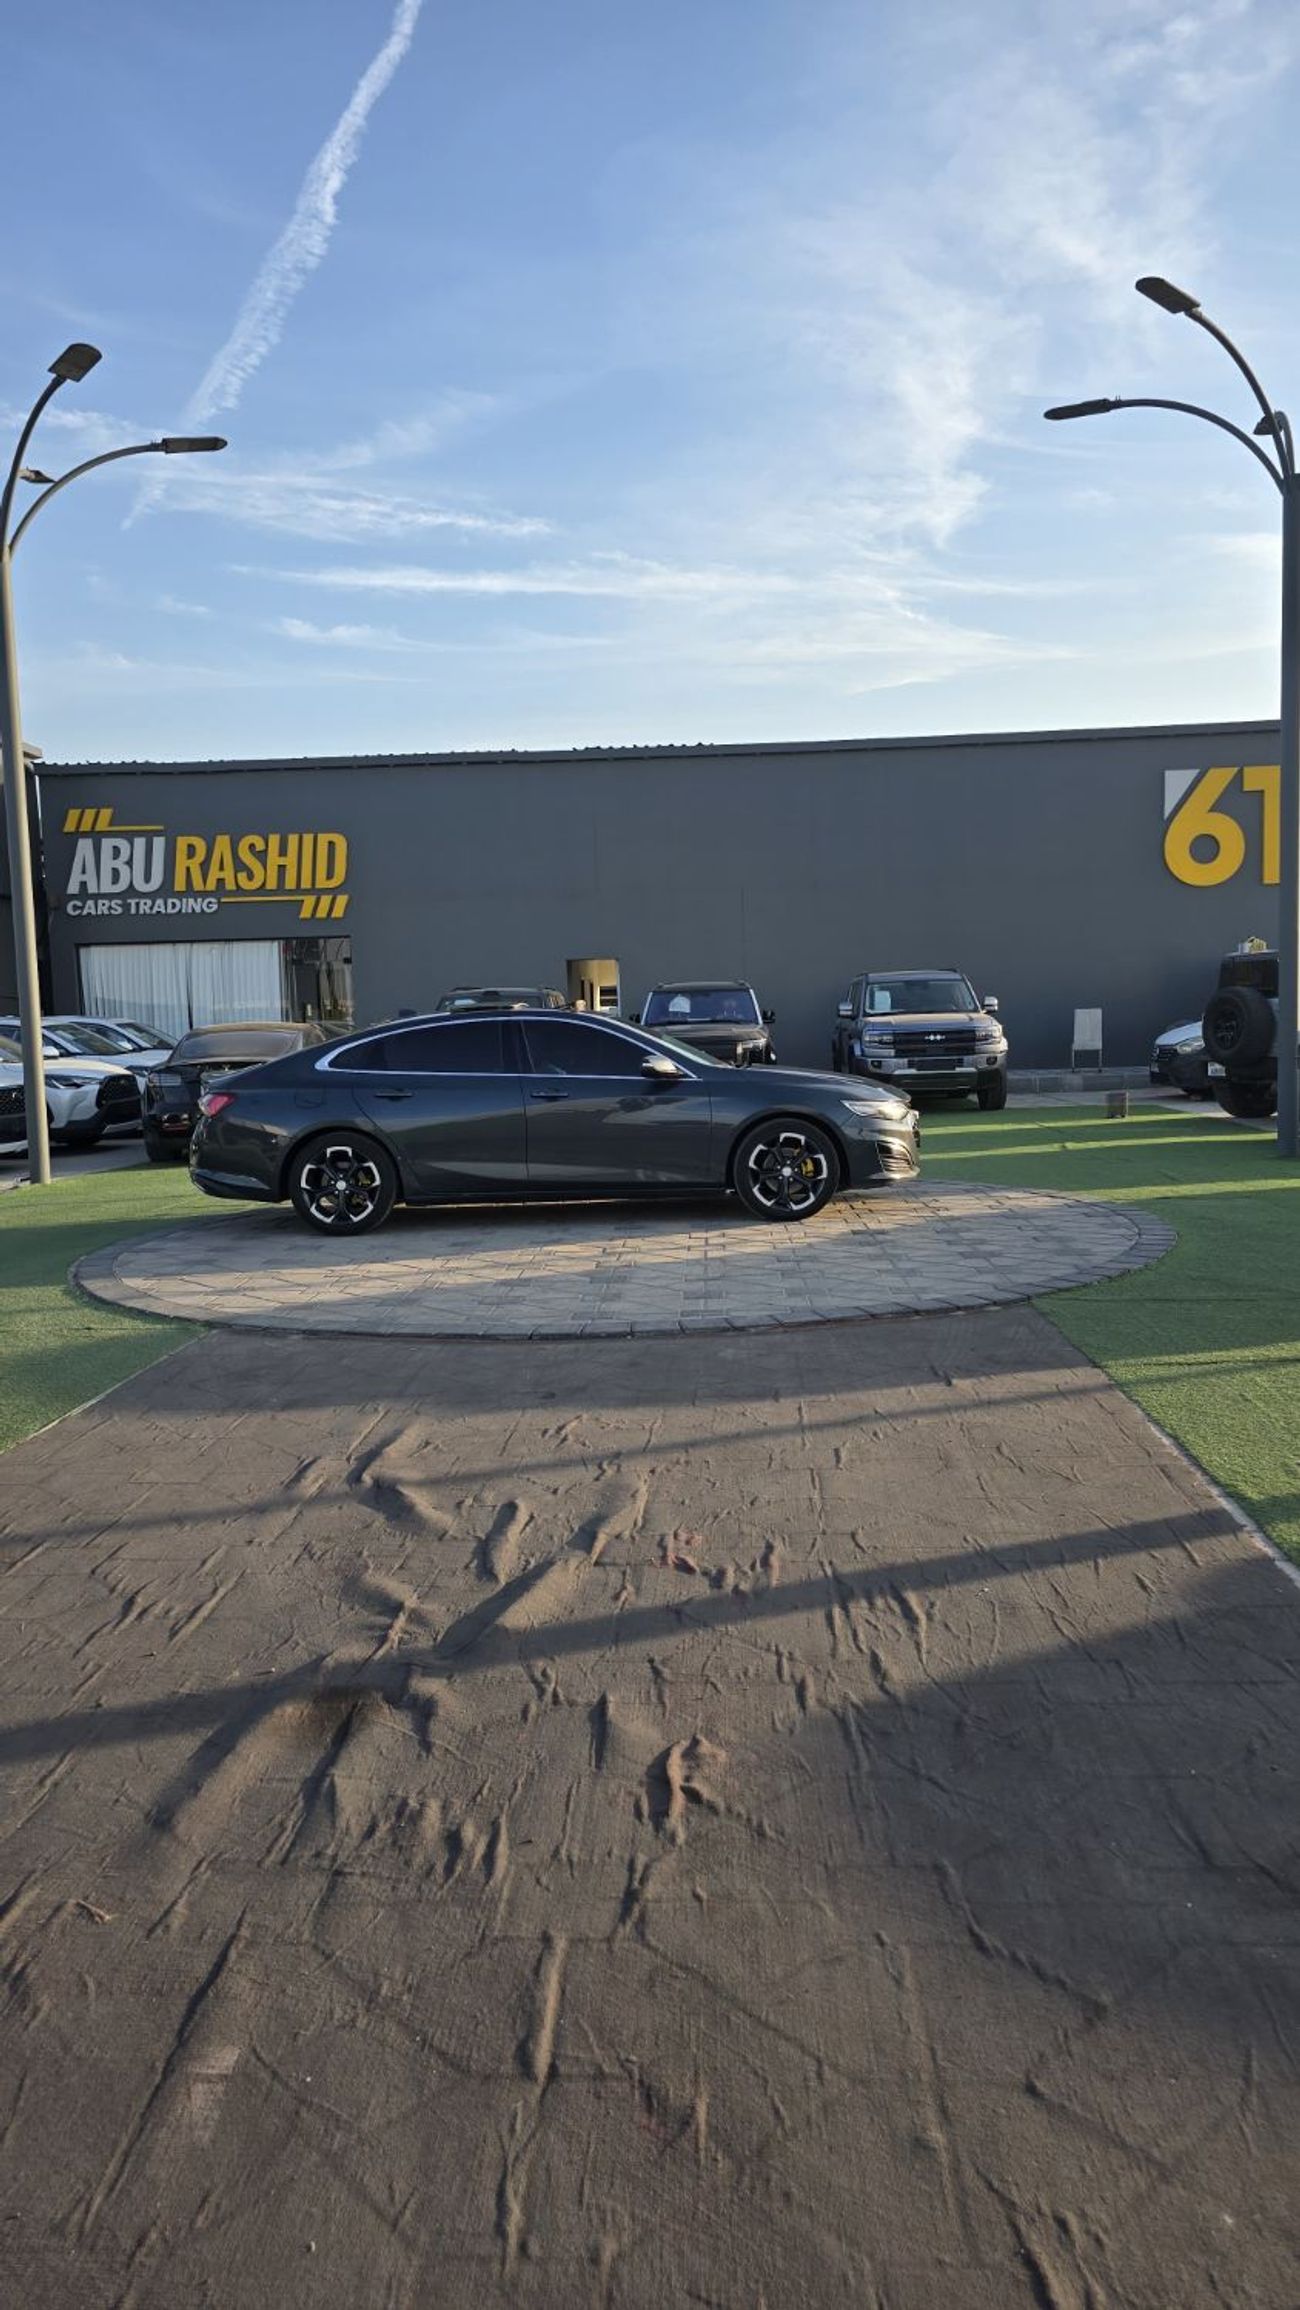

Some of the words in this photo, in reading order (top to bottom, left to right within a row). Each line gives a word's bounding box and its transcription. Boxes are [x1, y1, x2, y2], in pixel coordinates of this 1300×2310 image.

[1164, 764, 1281, 887] 61
[66, 836, 165, 895] ABU
[174, 832, 347, 892] RASHID
[67, 899, 123, 916] CARS
[127, 897, 219, 915] TRADING
